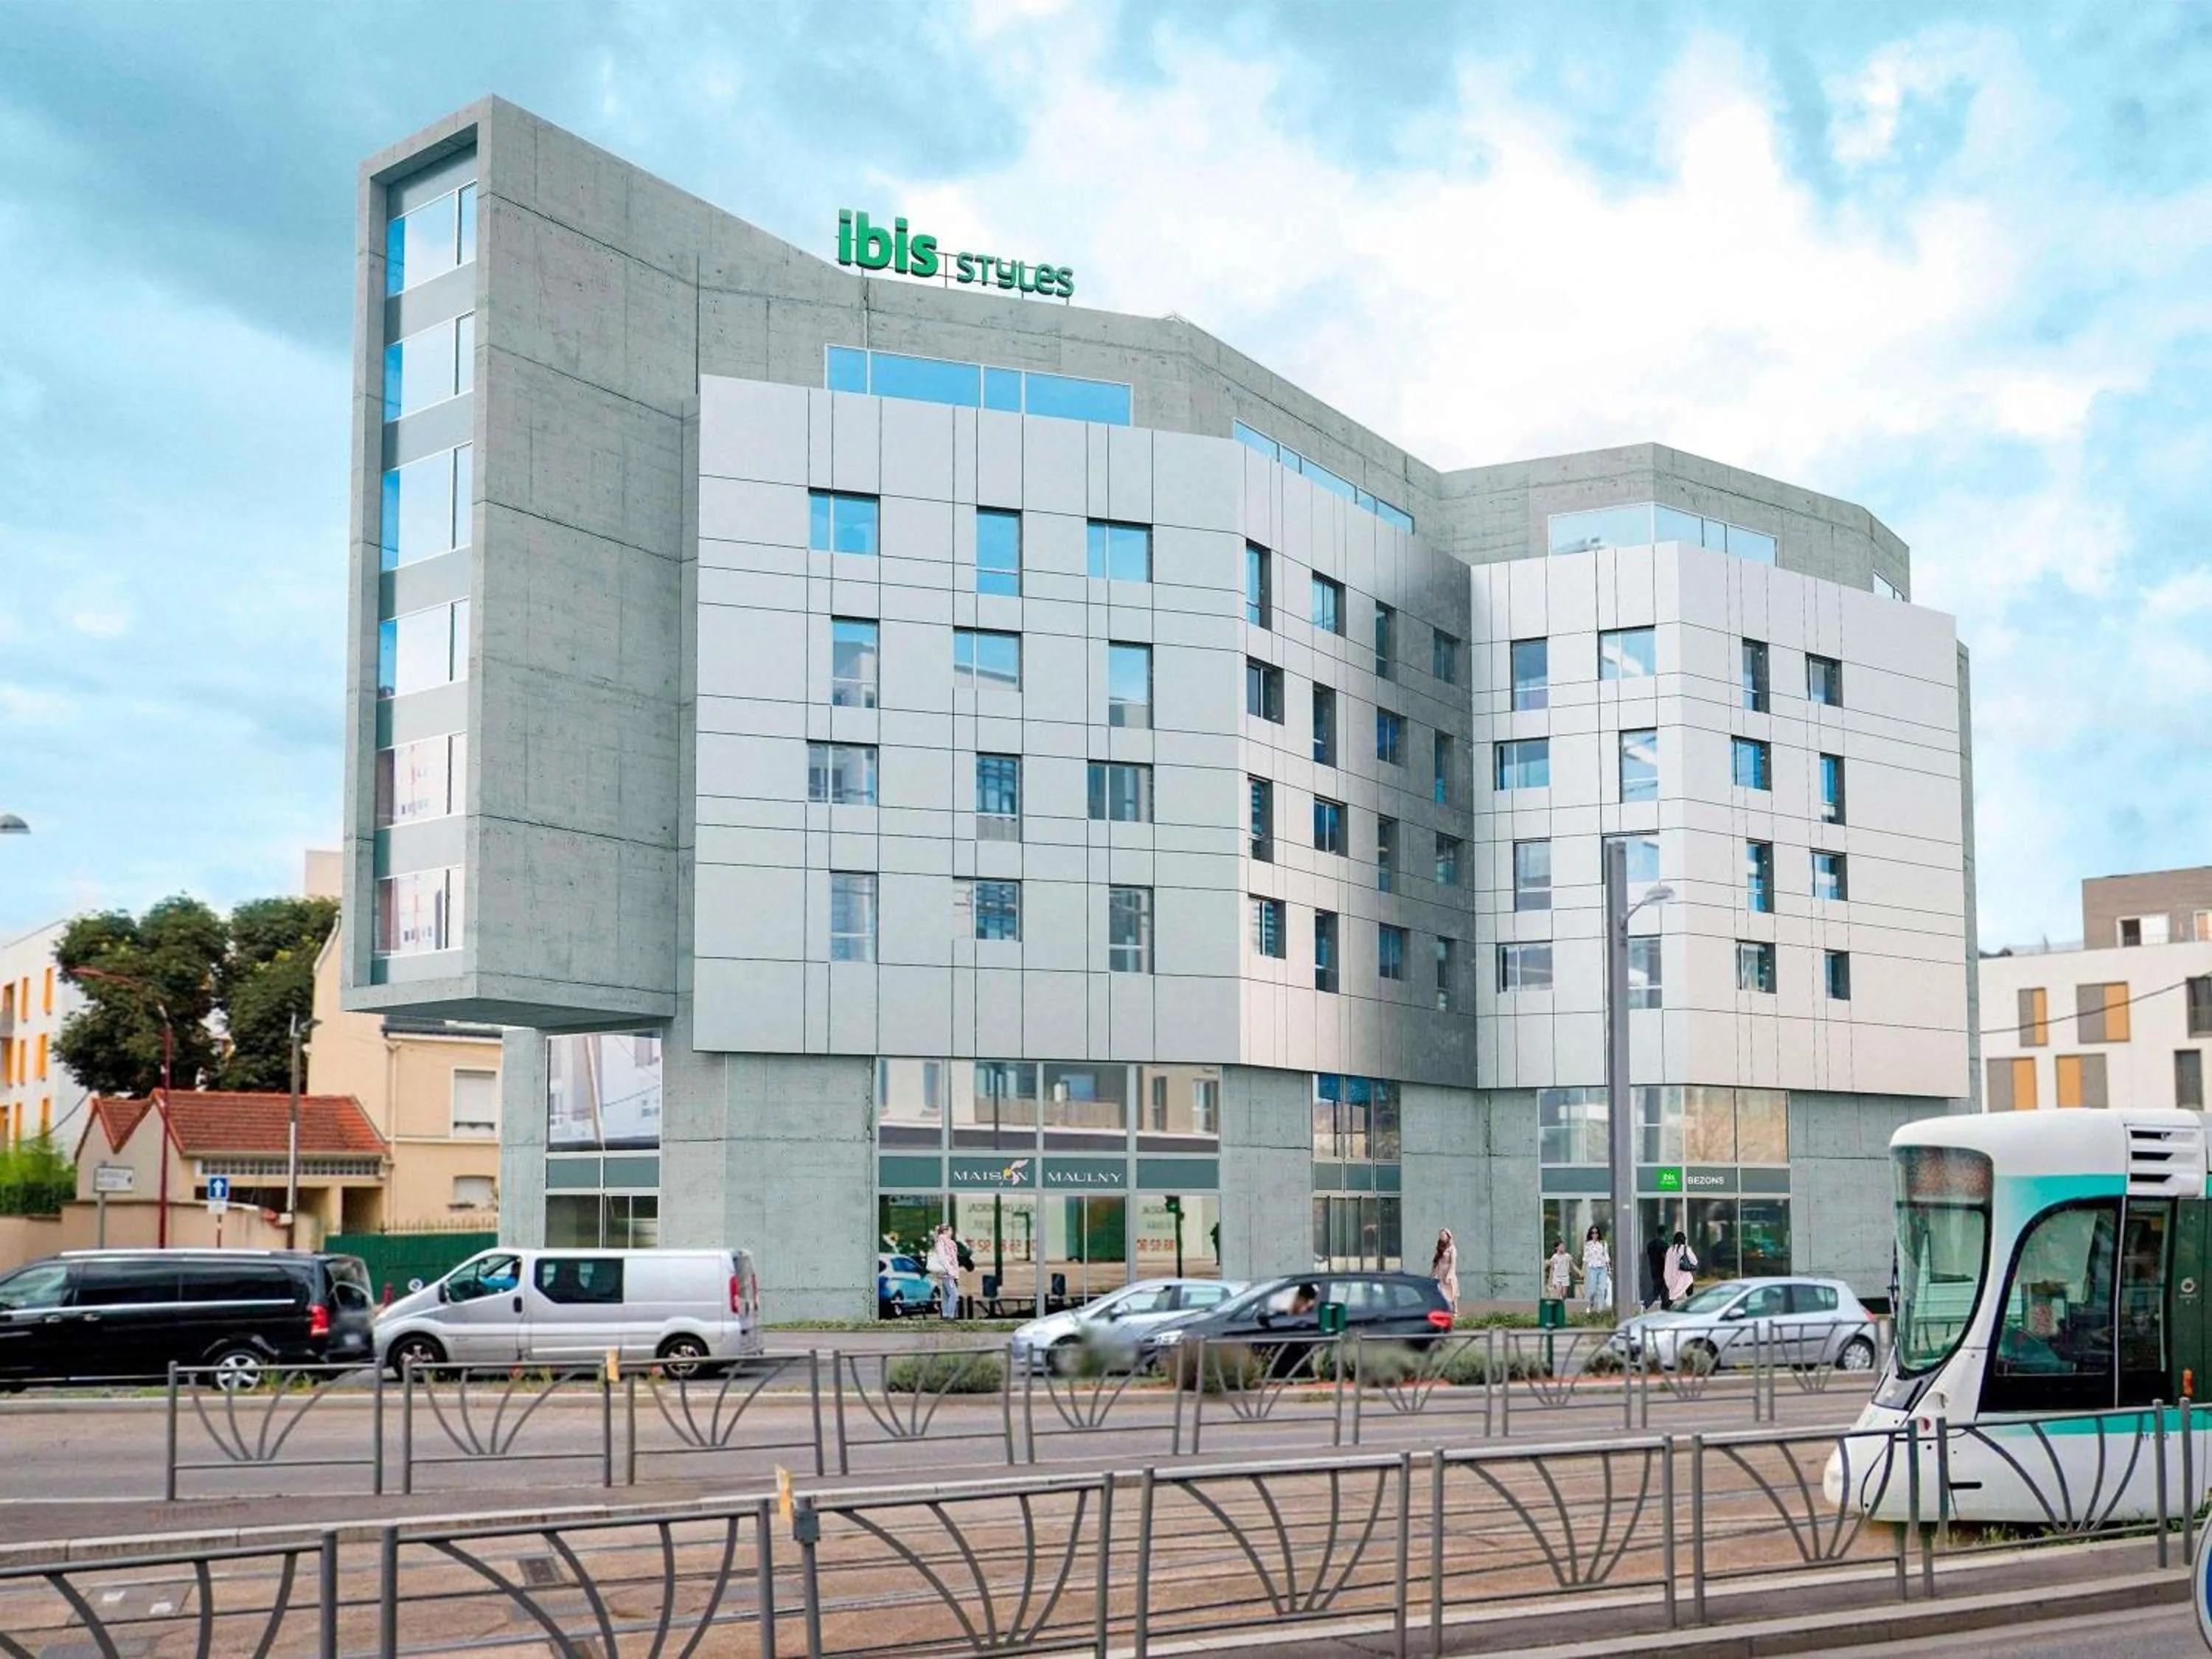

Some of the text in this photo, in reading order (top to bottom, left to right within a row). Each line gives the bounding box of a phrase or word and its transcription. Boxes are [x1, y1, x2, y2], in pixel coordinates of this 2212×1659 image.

[838, 208, 939, 278] ibis
[1047, 1172, 1121, 1183] MAULNY
[1687, 1176, 1724, 1185] BEZONS
